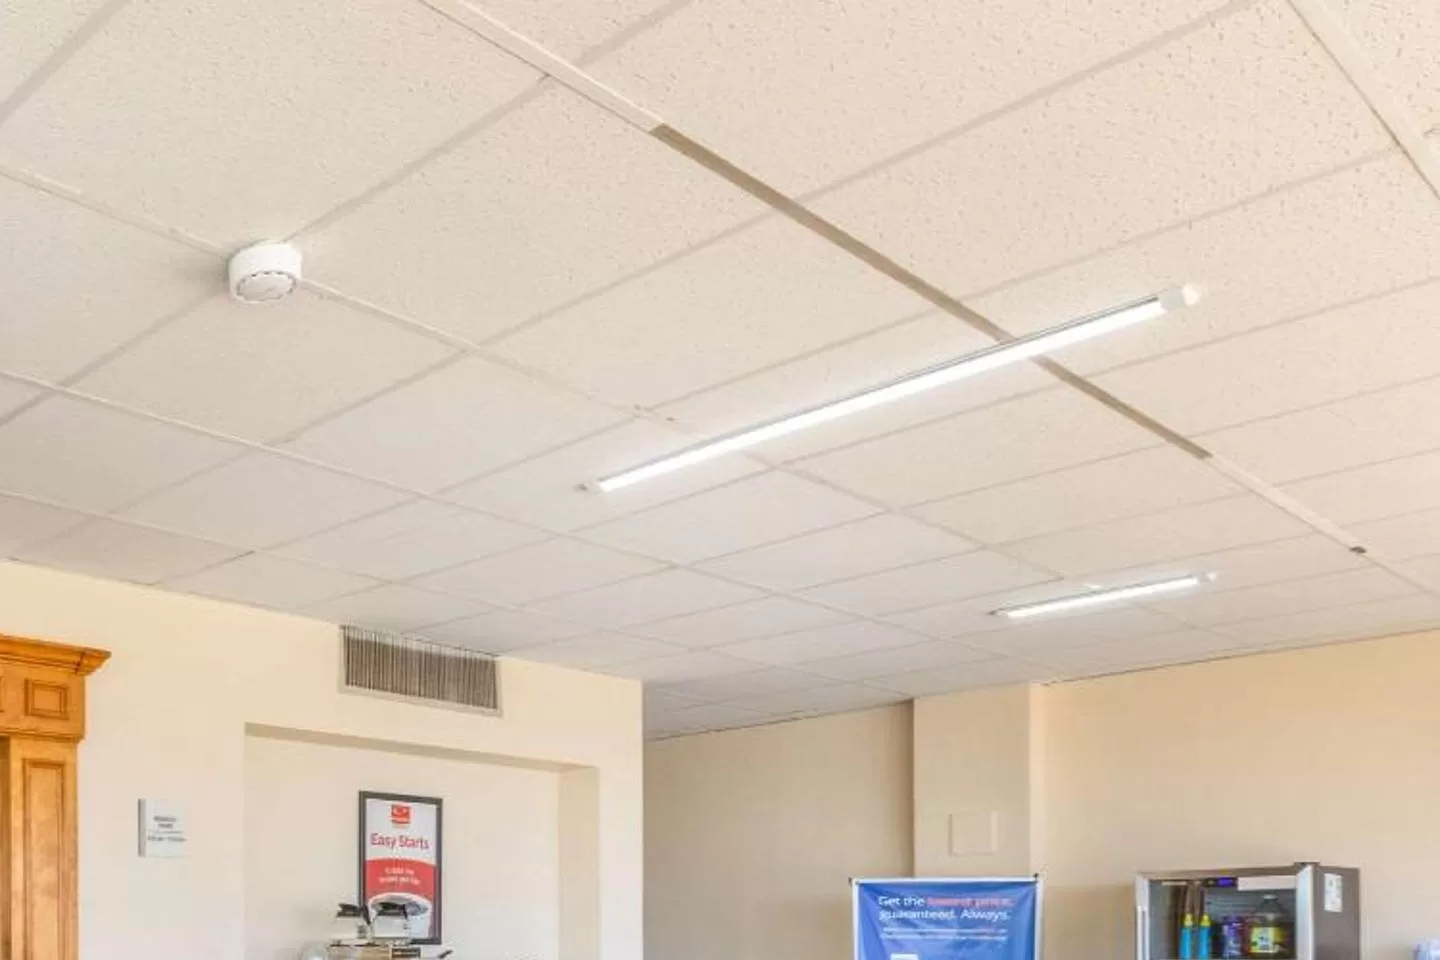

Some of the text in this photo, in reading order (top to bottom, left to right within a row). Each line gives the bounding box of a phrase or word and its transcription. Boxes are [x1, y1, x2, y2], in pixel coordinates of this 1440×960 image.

[371, 833, 429, 851] Easy Starts
[878, 896, 900, 906] Get
[903, 896, 925, 906] the
